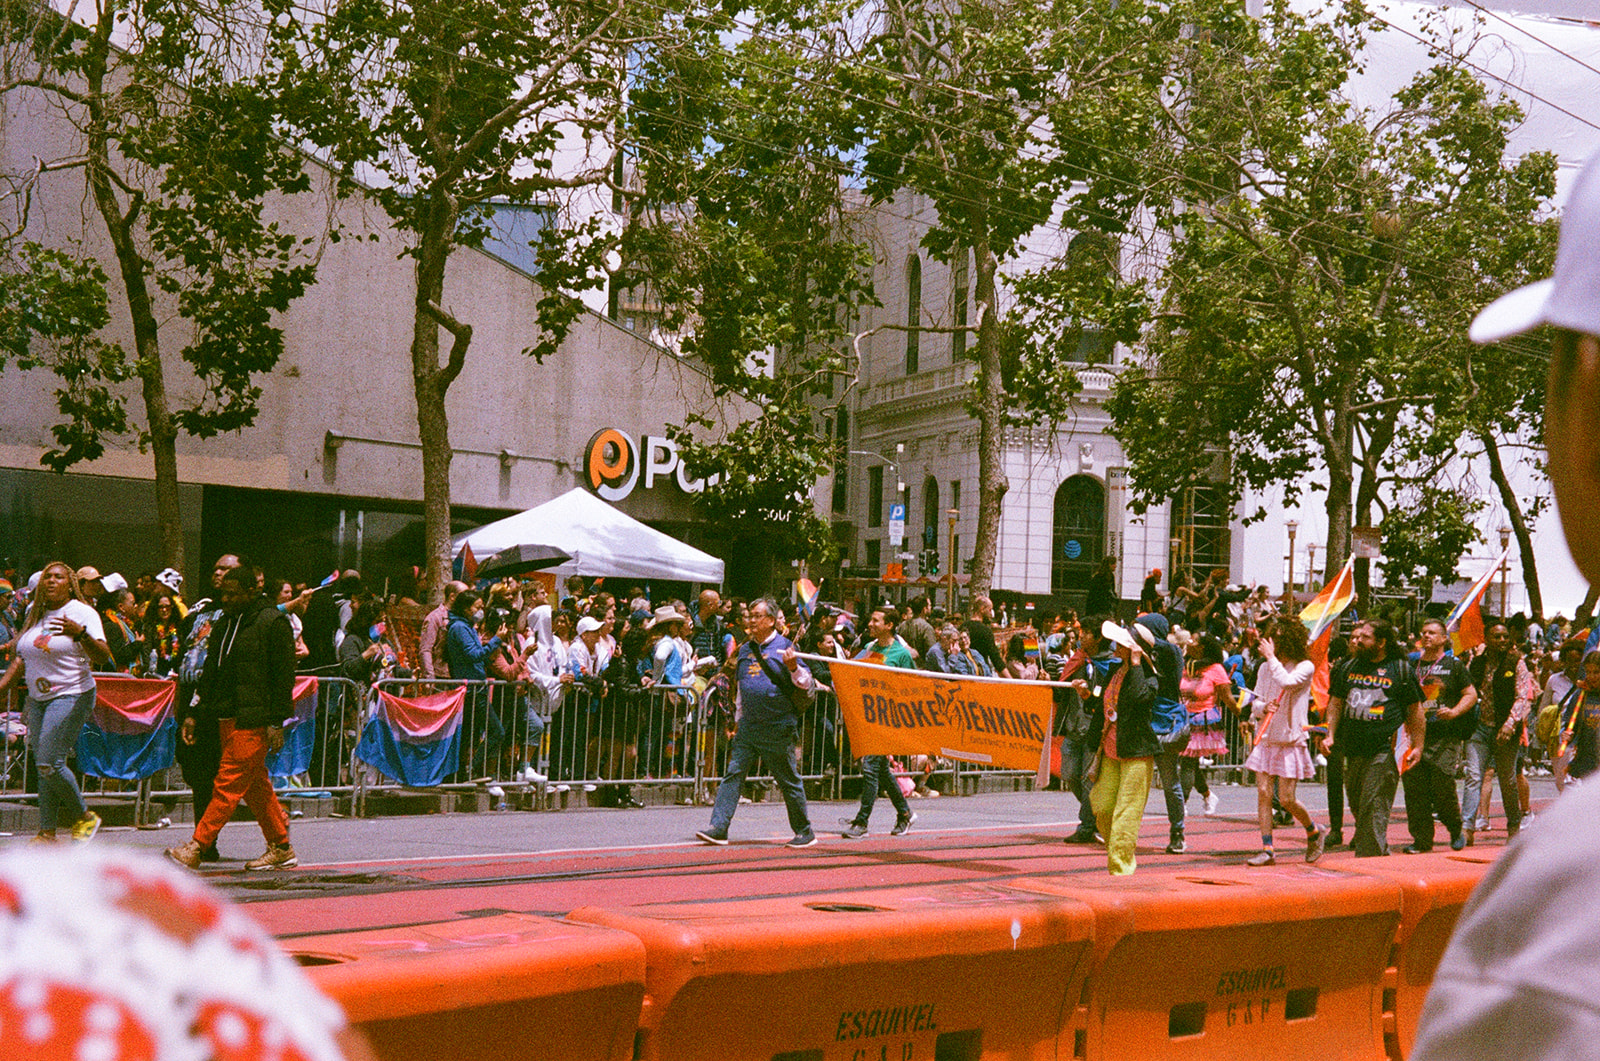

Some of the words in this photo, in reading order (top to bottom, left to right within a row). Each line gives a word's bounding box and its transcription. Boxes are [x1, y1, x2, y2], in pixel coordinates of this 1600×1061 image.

[1347, 673, 1392, 689] PROUD
[862, 693, 945, 729] BROOKE
[958, 700, 1045, 743] JENKINS
[836, 1003, 937, 1041] ESQUIVEL
